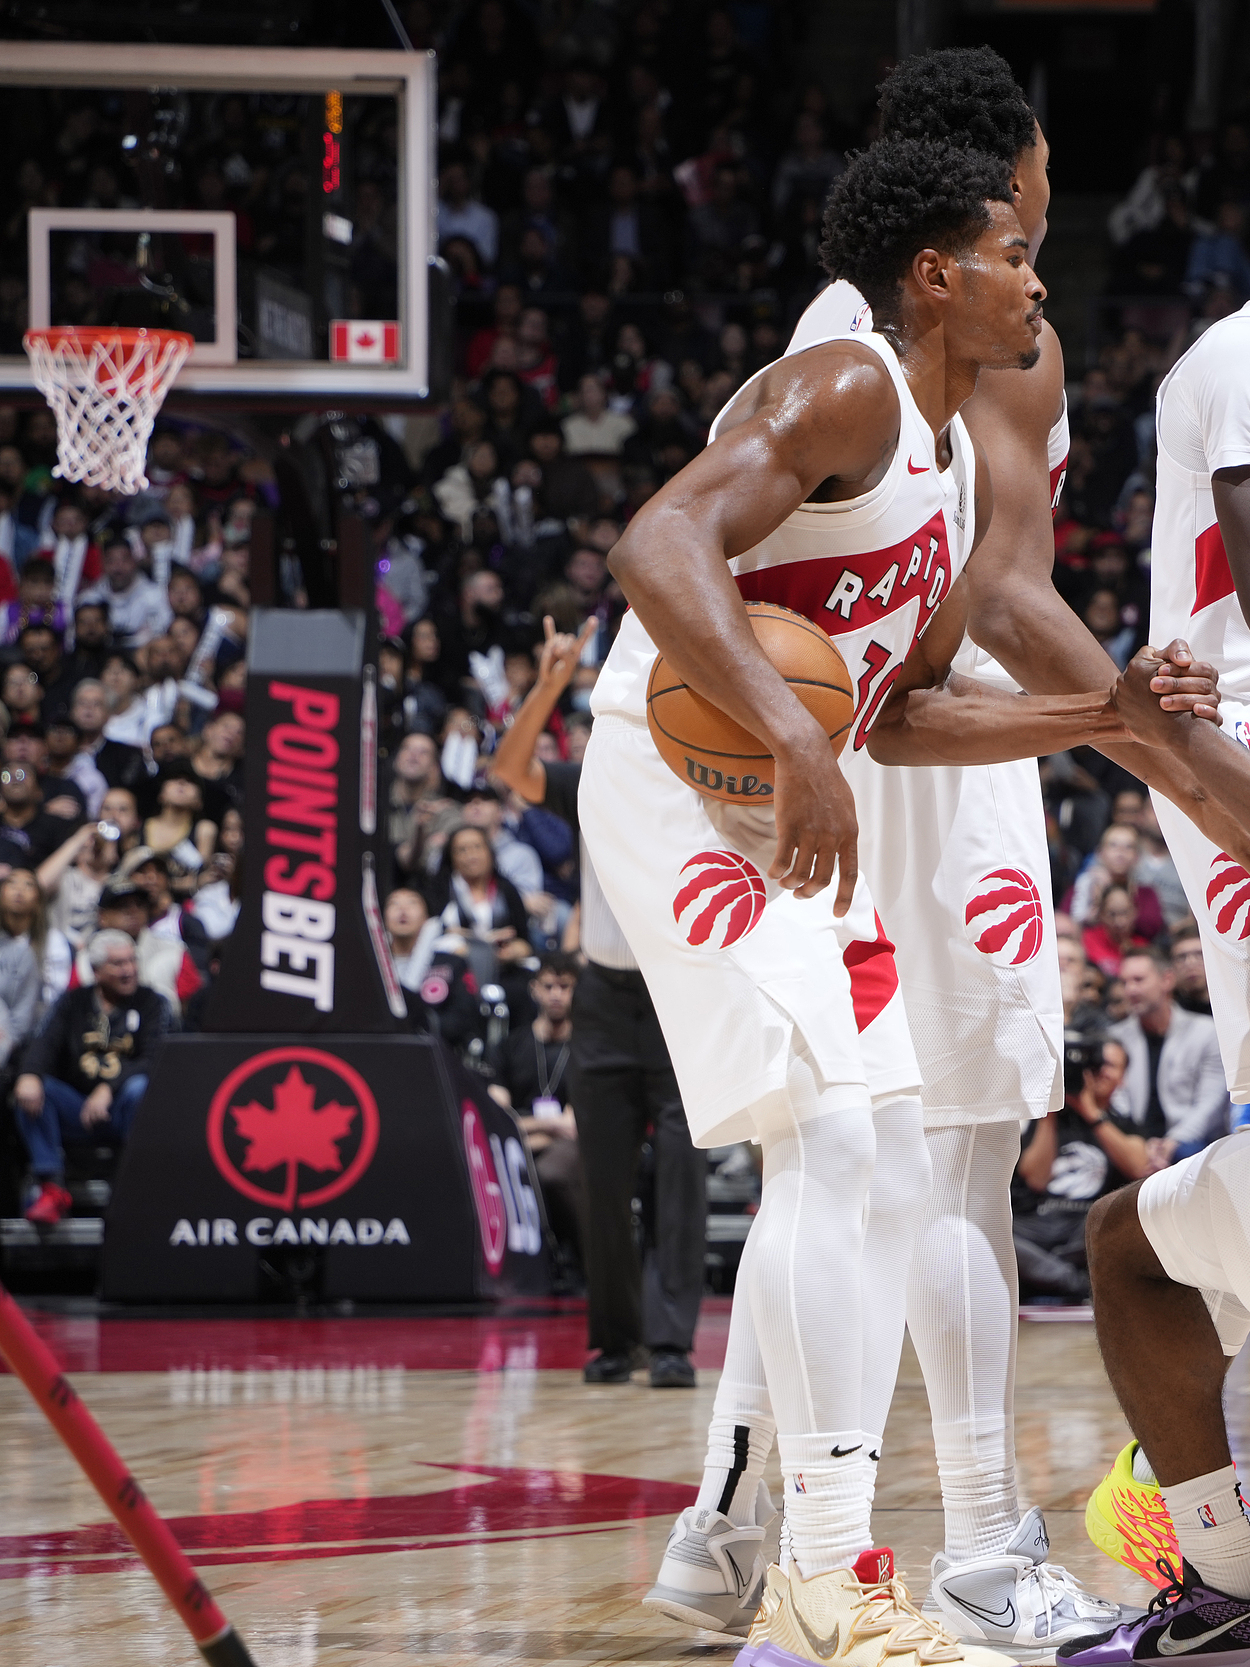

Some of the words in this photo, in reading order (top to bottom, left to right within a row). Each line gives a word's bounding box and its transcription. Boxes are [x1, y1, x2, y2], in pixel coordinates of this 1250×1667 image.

[823, 535, 945, 641] RAPTO
[684, 756, 774, 796] Wils
[260, 680, 341, 1013] POINTSBET
[169, 1217, 239, 1246] AIR
[245, 1217, 411, 1246] CANADA
